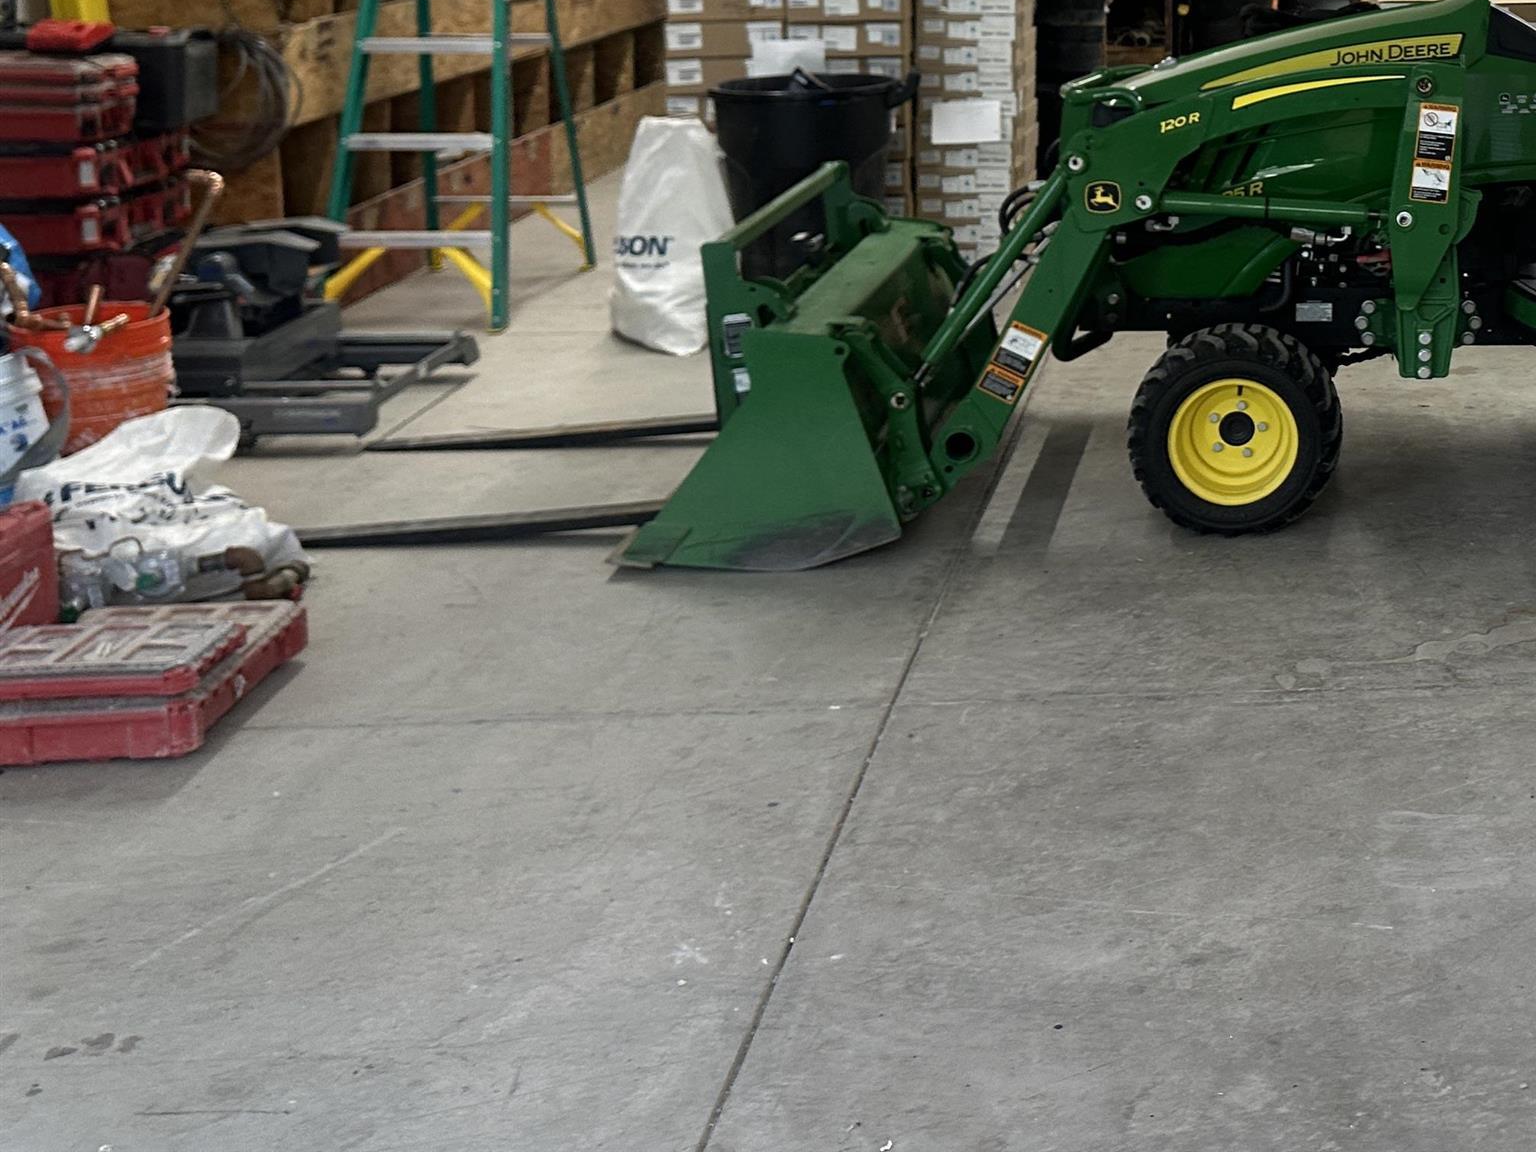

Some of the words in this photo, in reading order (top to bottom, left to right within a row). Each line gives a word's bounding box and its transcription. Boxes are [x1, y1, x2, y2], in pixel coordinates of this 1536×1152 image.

[1330, 50, 1383, 66] JOHN
[1388, 42, 1451, 61] DEERE
[1160, 115, 1186, 133] 120
[1188, 112, 1200, 124] R
